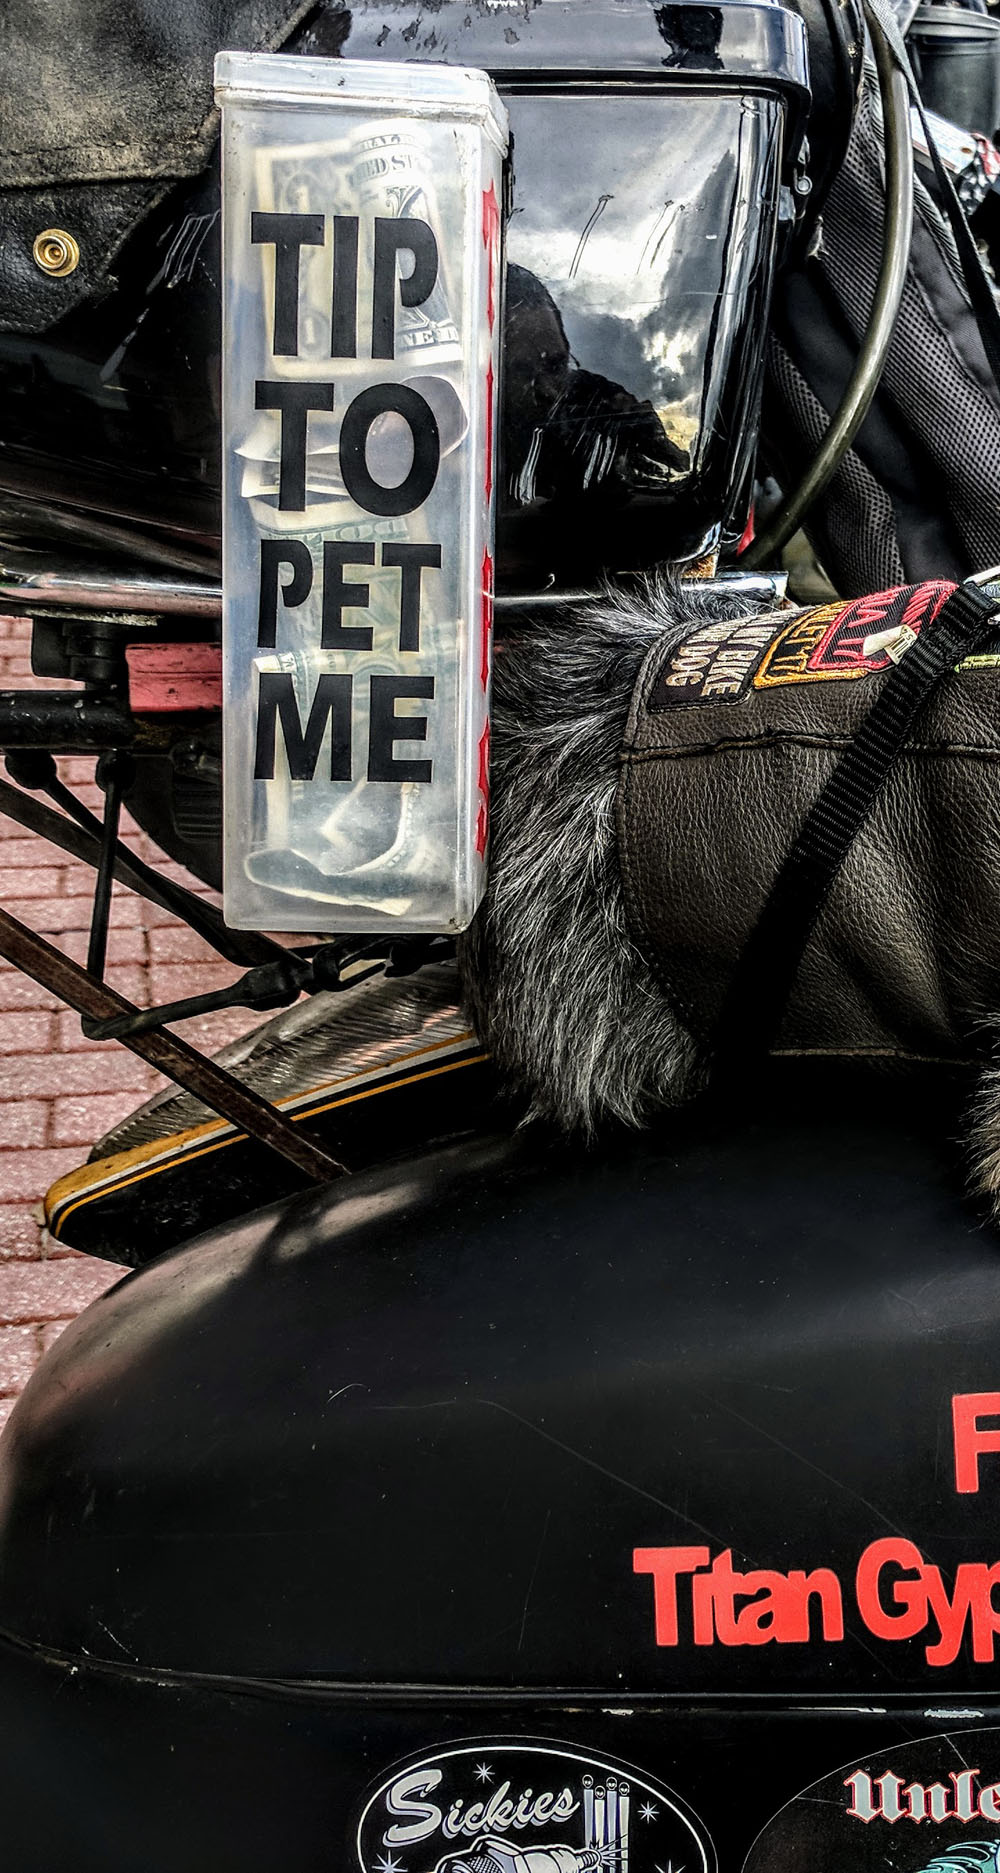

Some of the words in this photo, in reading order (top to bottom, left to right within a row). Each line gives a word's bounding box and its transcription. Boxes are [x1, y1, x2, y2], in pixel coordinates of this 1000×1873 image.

[251, 212, 438, 360] TIP
[255, 380, 440, 517] TO
[257, 539, 442, 652] PET
[665, 644, 720, 687] DOG
[700, 649, 759, 697] BIKE
[254, 672, 435, 783] ME
[632, 1546, 844, 1647] Titan
[383, 1769, 581, 1848] Sickies
